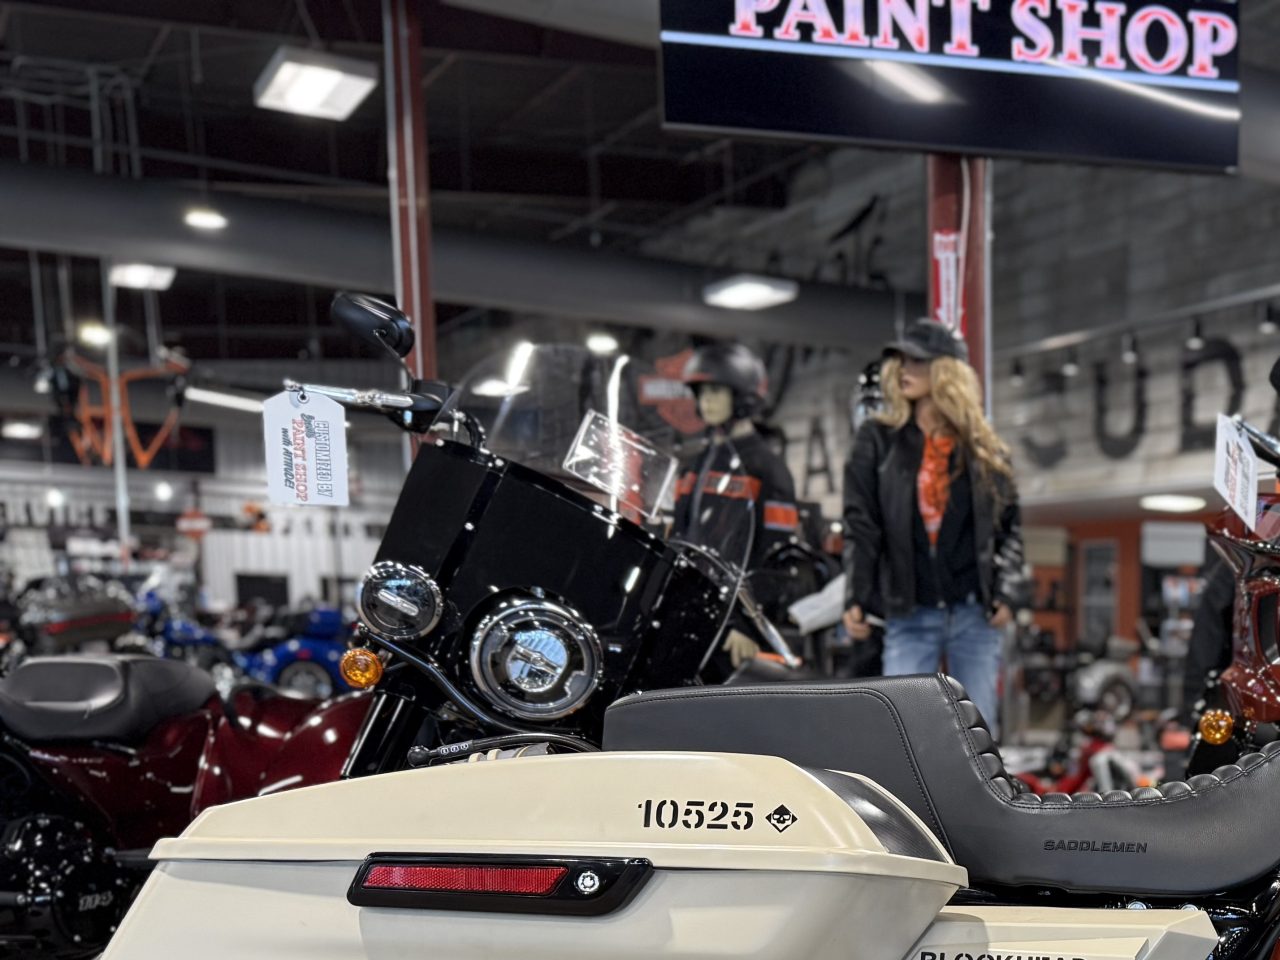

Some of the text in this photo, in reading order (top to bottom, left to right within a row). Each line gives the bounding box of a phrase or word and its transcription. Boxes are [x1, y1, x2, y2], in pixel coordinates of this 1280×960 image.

[729, 0, 1238, 78] PAINT SHOP
[281, 428, 295, 489] with ATTITUDE!
[292, 419, 308, 501] PAINT SHOP
[314, 421, 333, 497] CUSTOMIZED BY
[638, 800, 753, 830] 10525
[1044, 840, 1147, 853] SADDLEMEN
